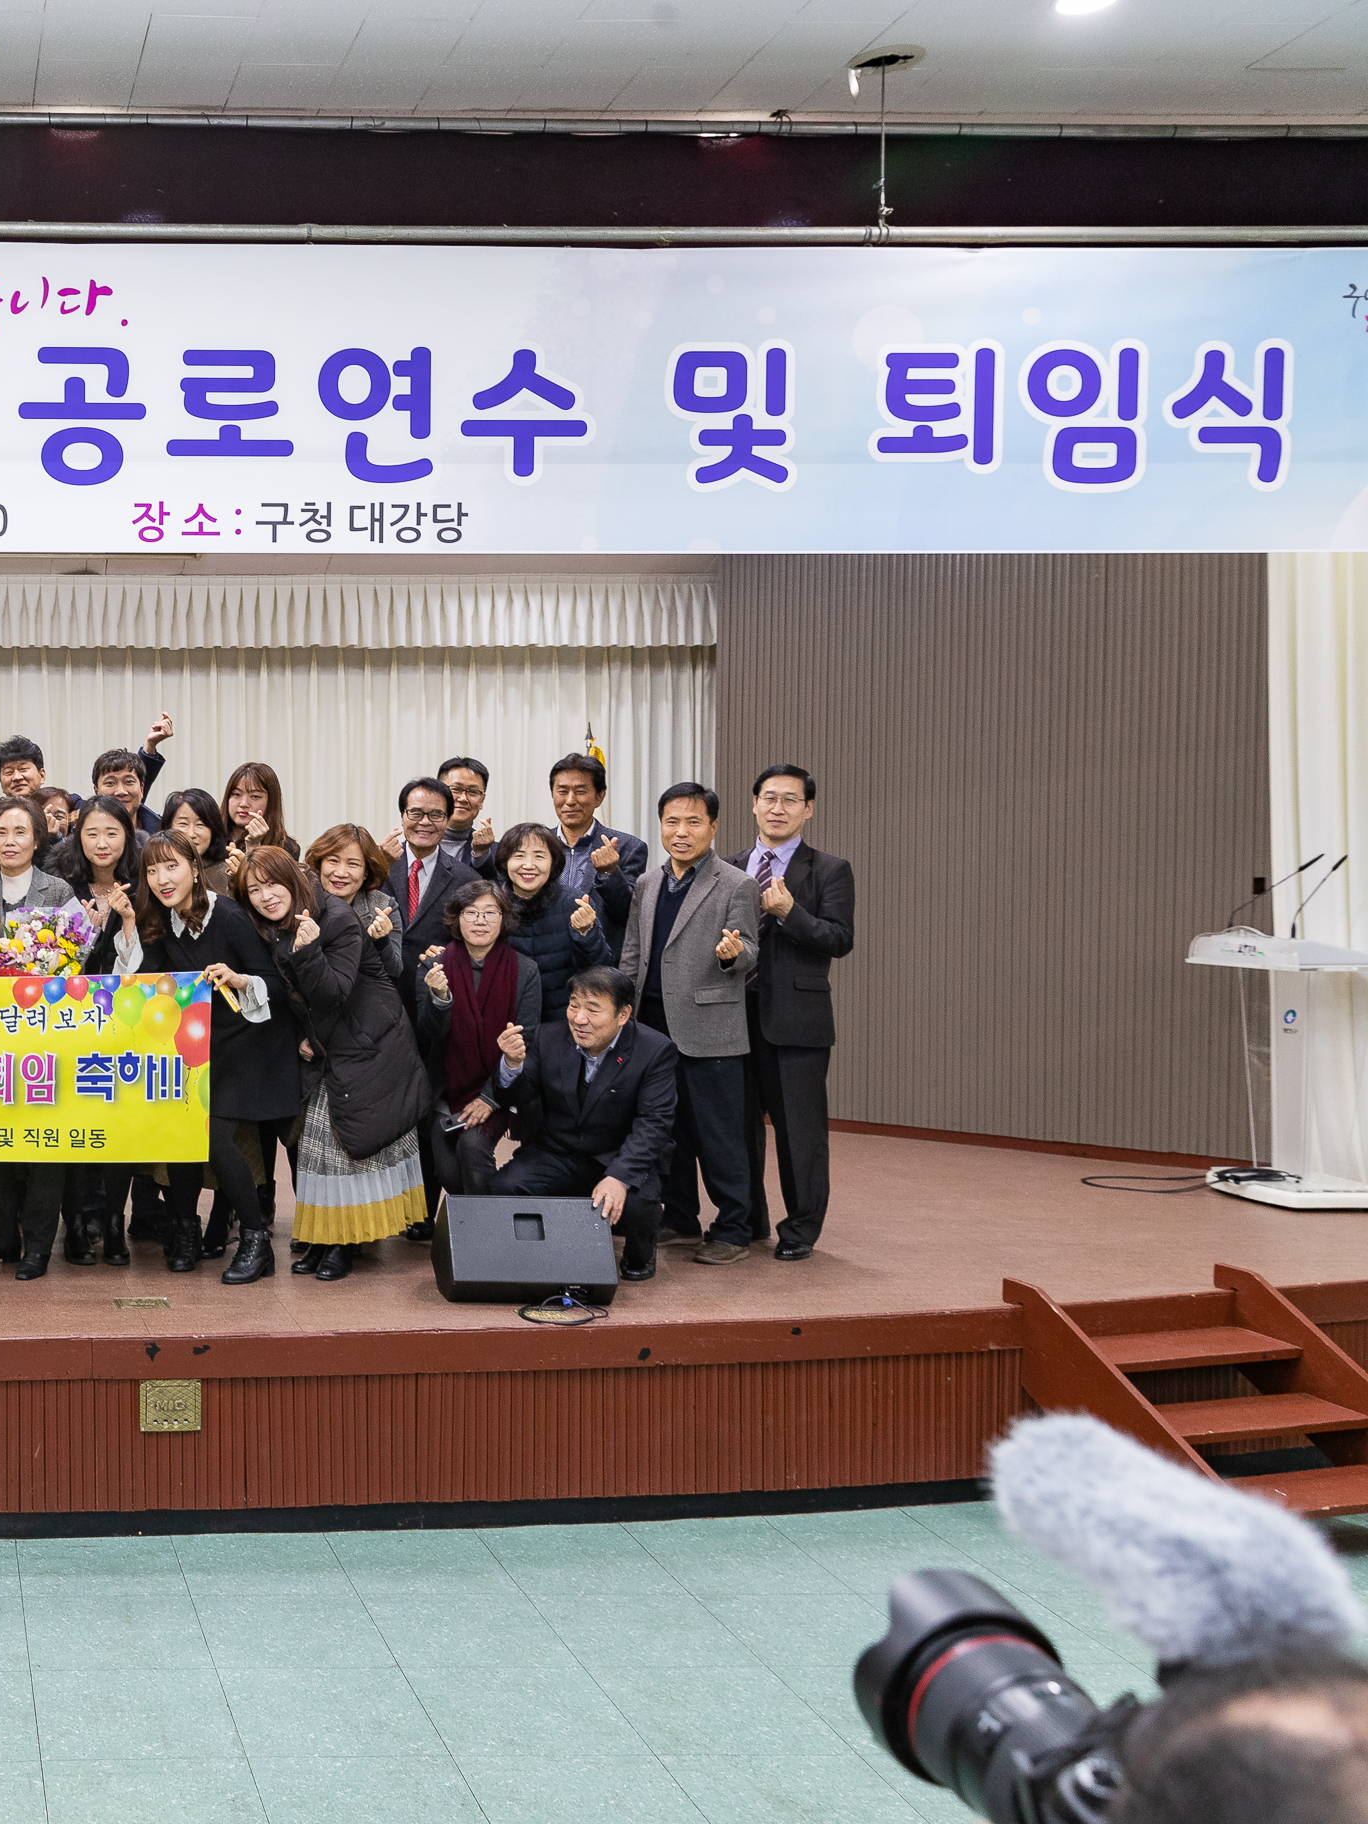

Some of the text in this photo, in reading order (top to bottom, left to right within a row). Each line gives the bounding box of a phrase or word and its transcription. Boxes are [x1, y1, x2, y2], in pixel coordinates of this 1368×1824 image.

[19, 347, 586, 485] 공로연수
[674, 348, 788, 483] 및
[877, 348, 1284, 484] 퇴임식
[256, 502, 331, 543] 구청
[350, 502, 468, 543] 대강당
[0, 1006, 106, 1032] 달려보자
[76, 1052, 181, 1100] 축하!!
[23, 1129, 58, 1147] 직원
[70, 1129, 106, 1148] 일동
